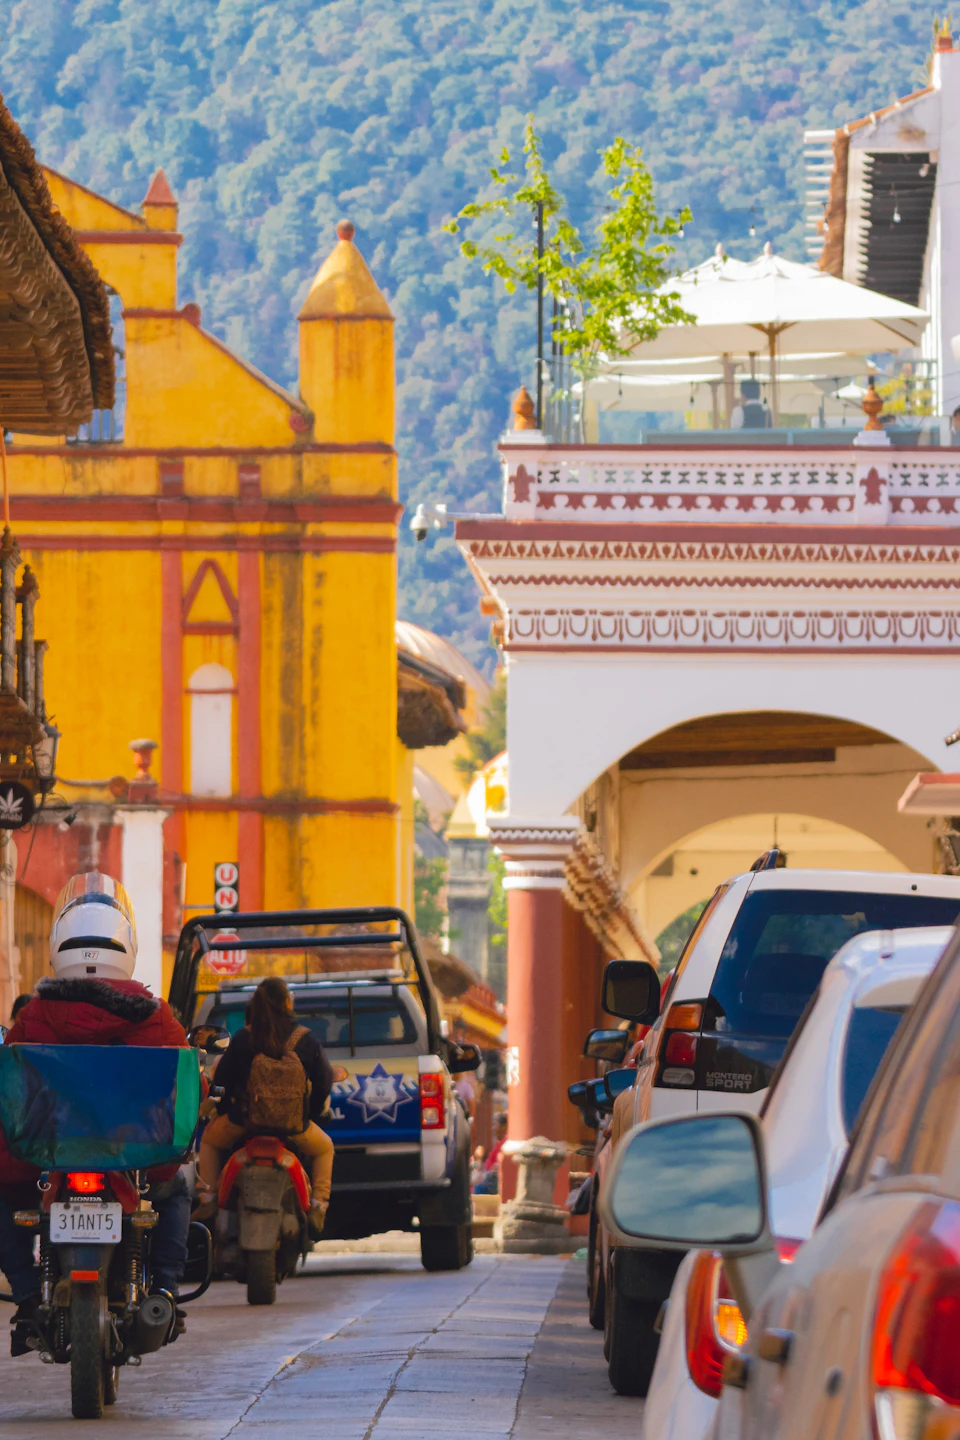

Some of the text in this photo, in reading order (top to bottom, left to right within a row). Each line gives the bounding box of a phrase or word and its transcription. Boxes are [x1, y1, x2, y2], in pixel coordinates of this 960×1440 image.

[84, 951, 97, 959] R7
[705, 1071, 753, 1081] MONTERO
[705, 1078, 752, 1090] SPORT
[58, 1213, 114, 1231] 31ANT5
